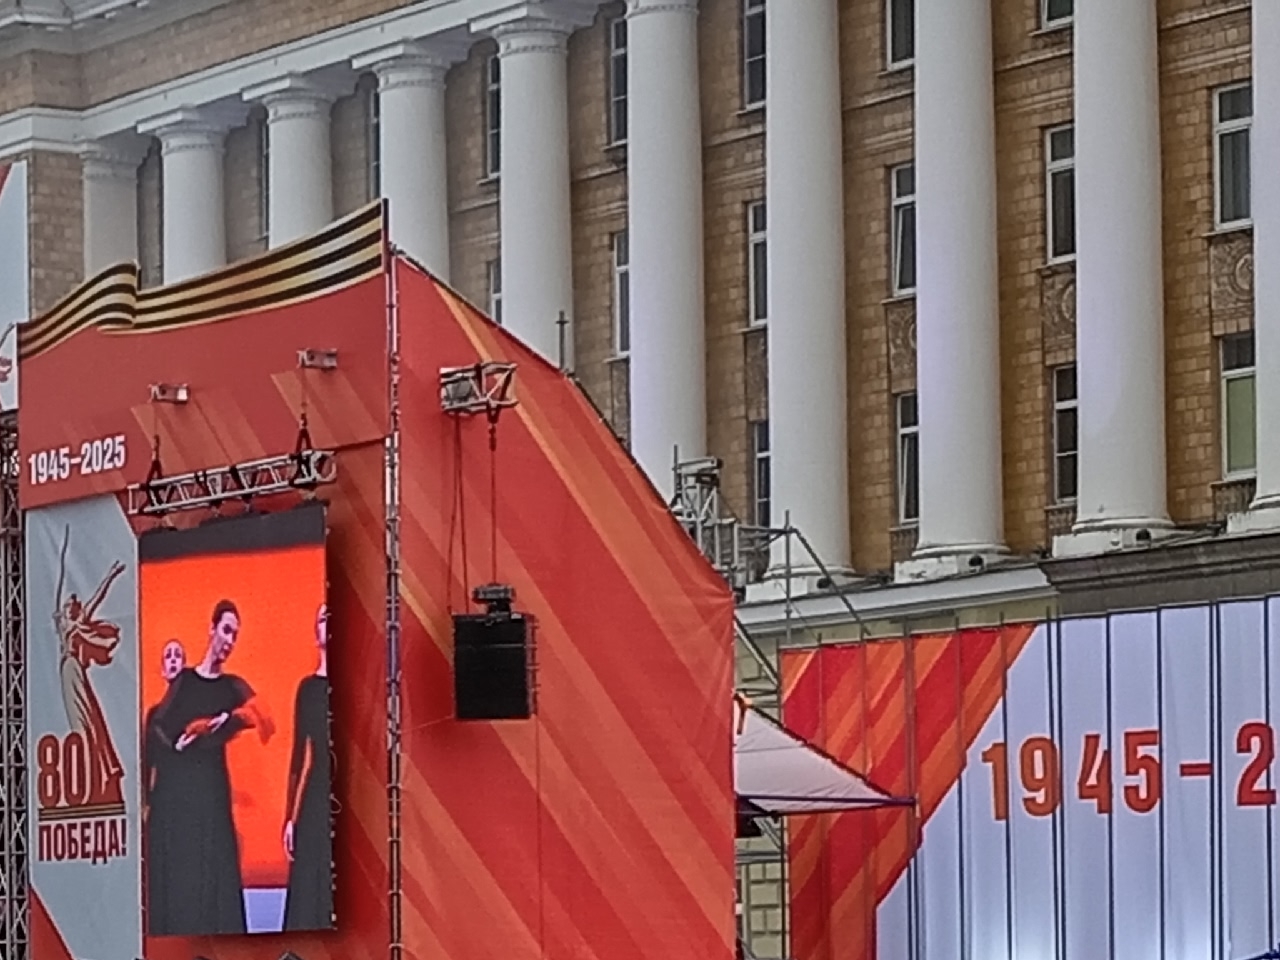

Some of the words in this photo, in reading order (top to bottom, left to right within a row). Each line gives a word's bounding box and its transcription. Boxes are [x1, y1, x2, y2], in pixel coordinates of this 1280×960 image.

[28, 435, 125, 485] 1945-2025
[38, 732, 87, 808] 80
[38, 818, 127, 865] ПОБЕДА!
